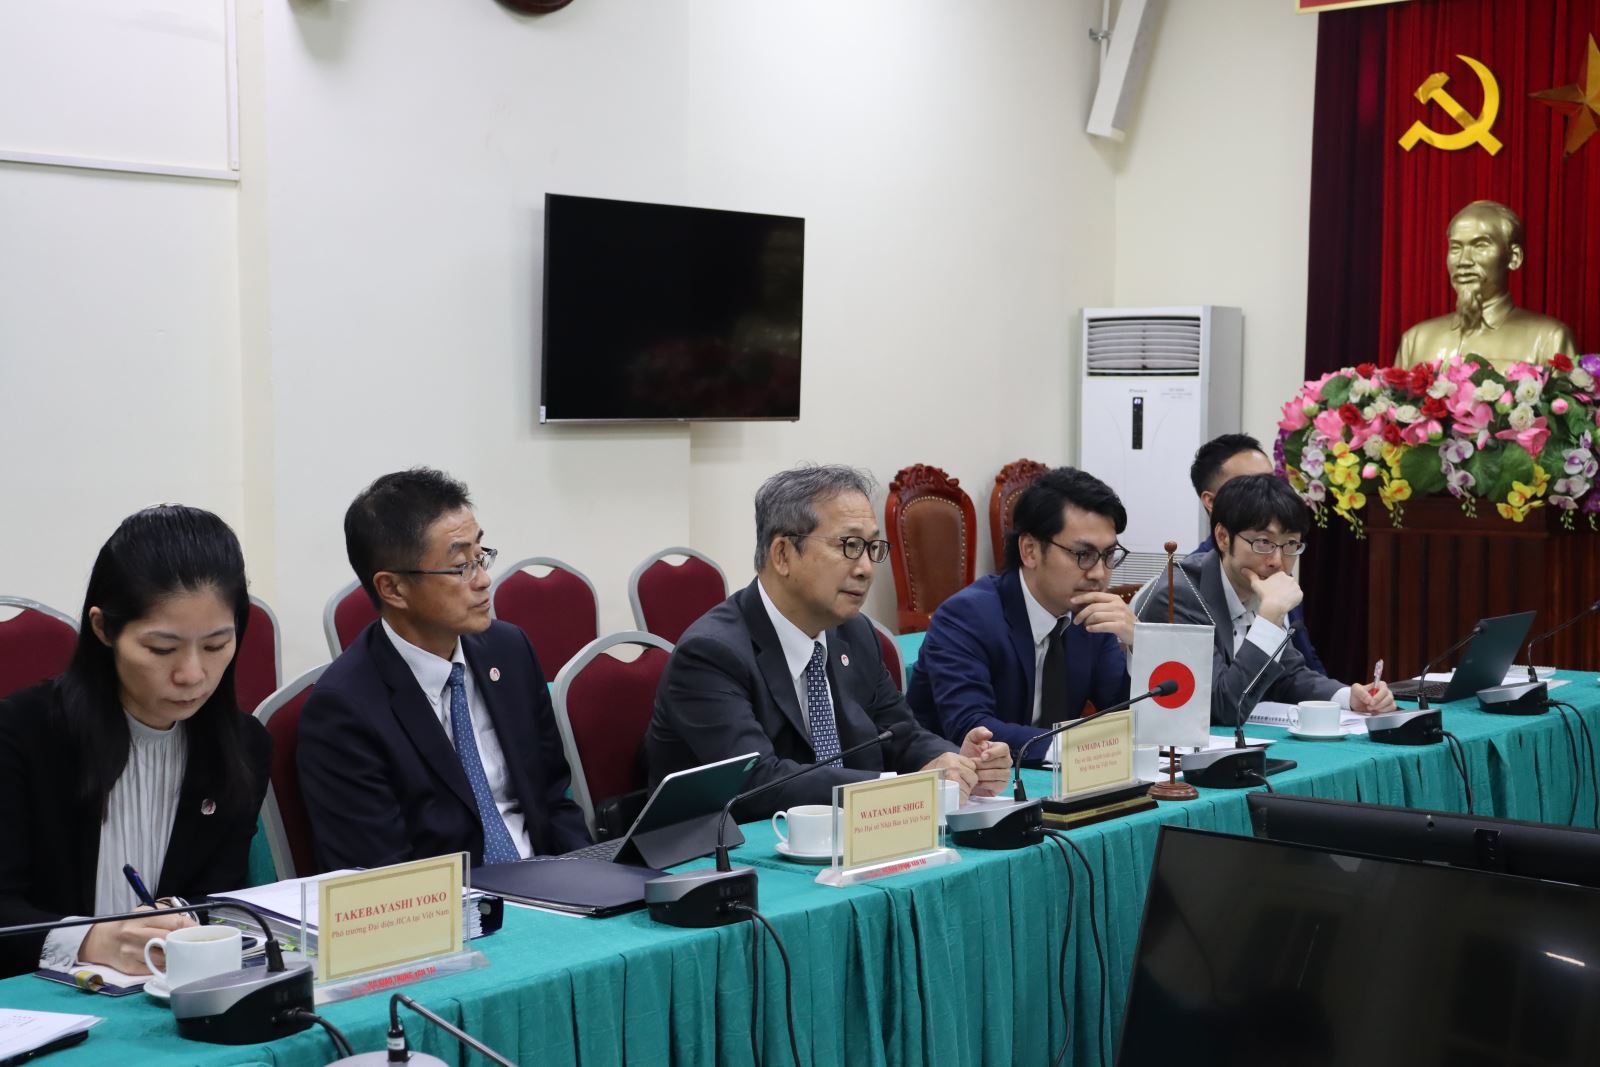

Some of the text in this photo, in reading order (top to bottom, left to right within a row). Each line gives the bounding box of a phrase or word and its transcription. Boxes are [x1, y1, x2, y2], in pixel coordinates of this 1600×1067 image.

[860, 800, 925, 820] WATANABE SHIGE
[334, 891, 447, 923] TAKEBAYASHI YOKO
[435, 908, 450, 917] Nam
